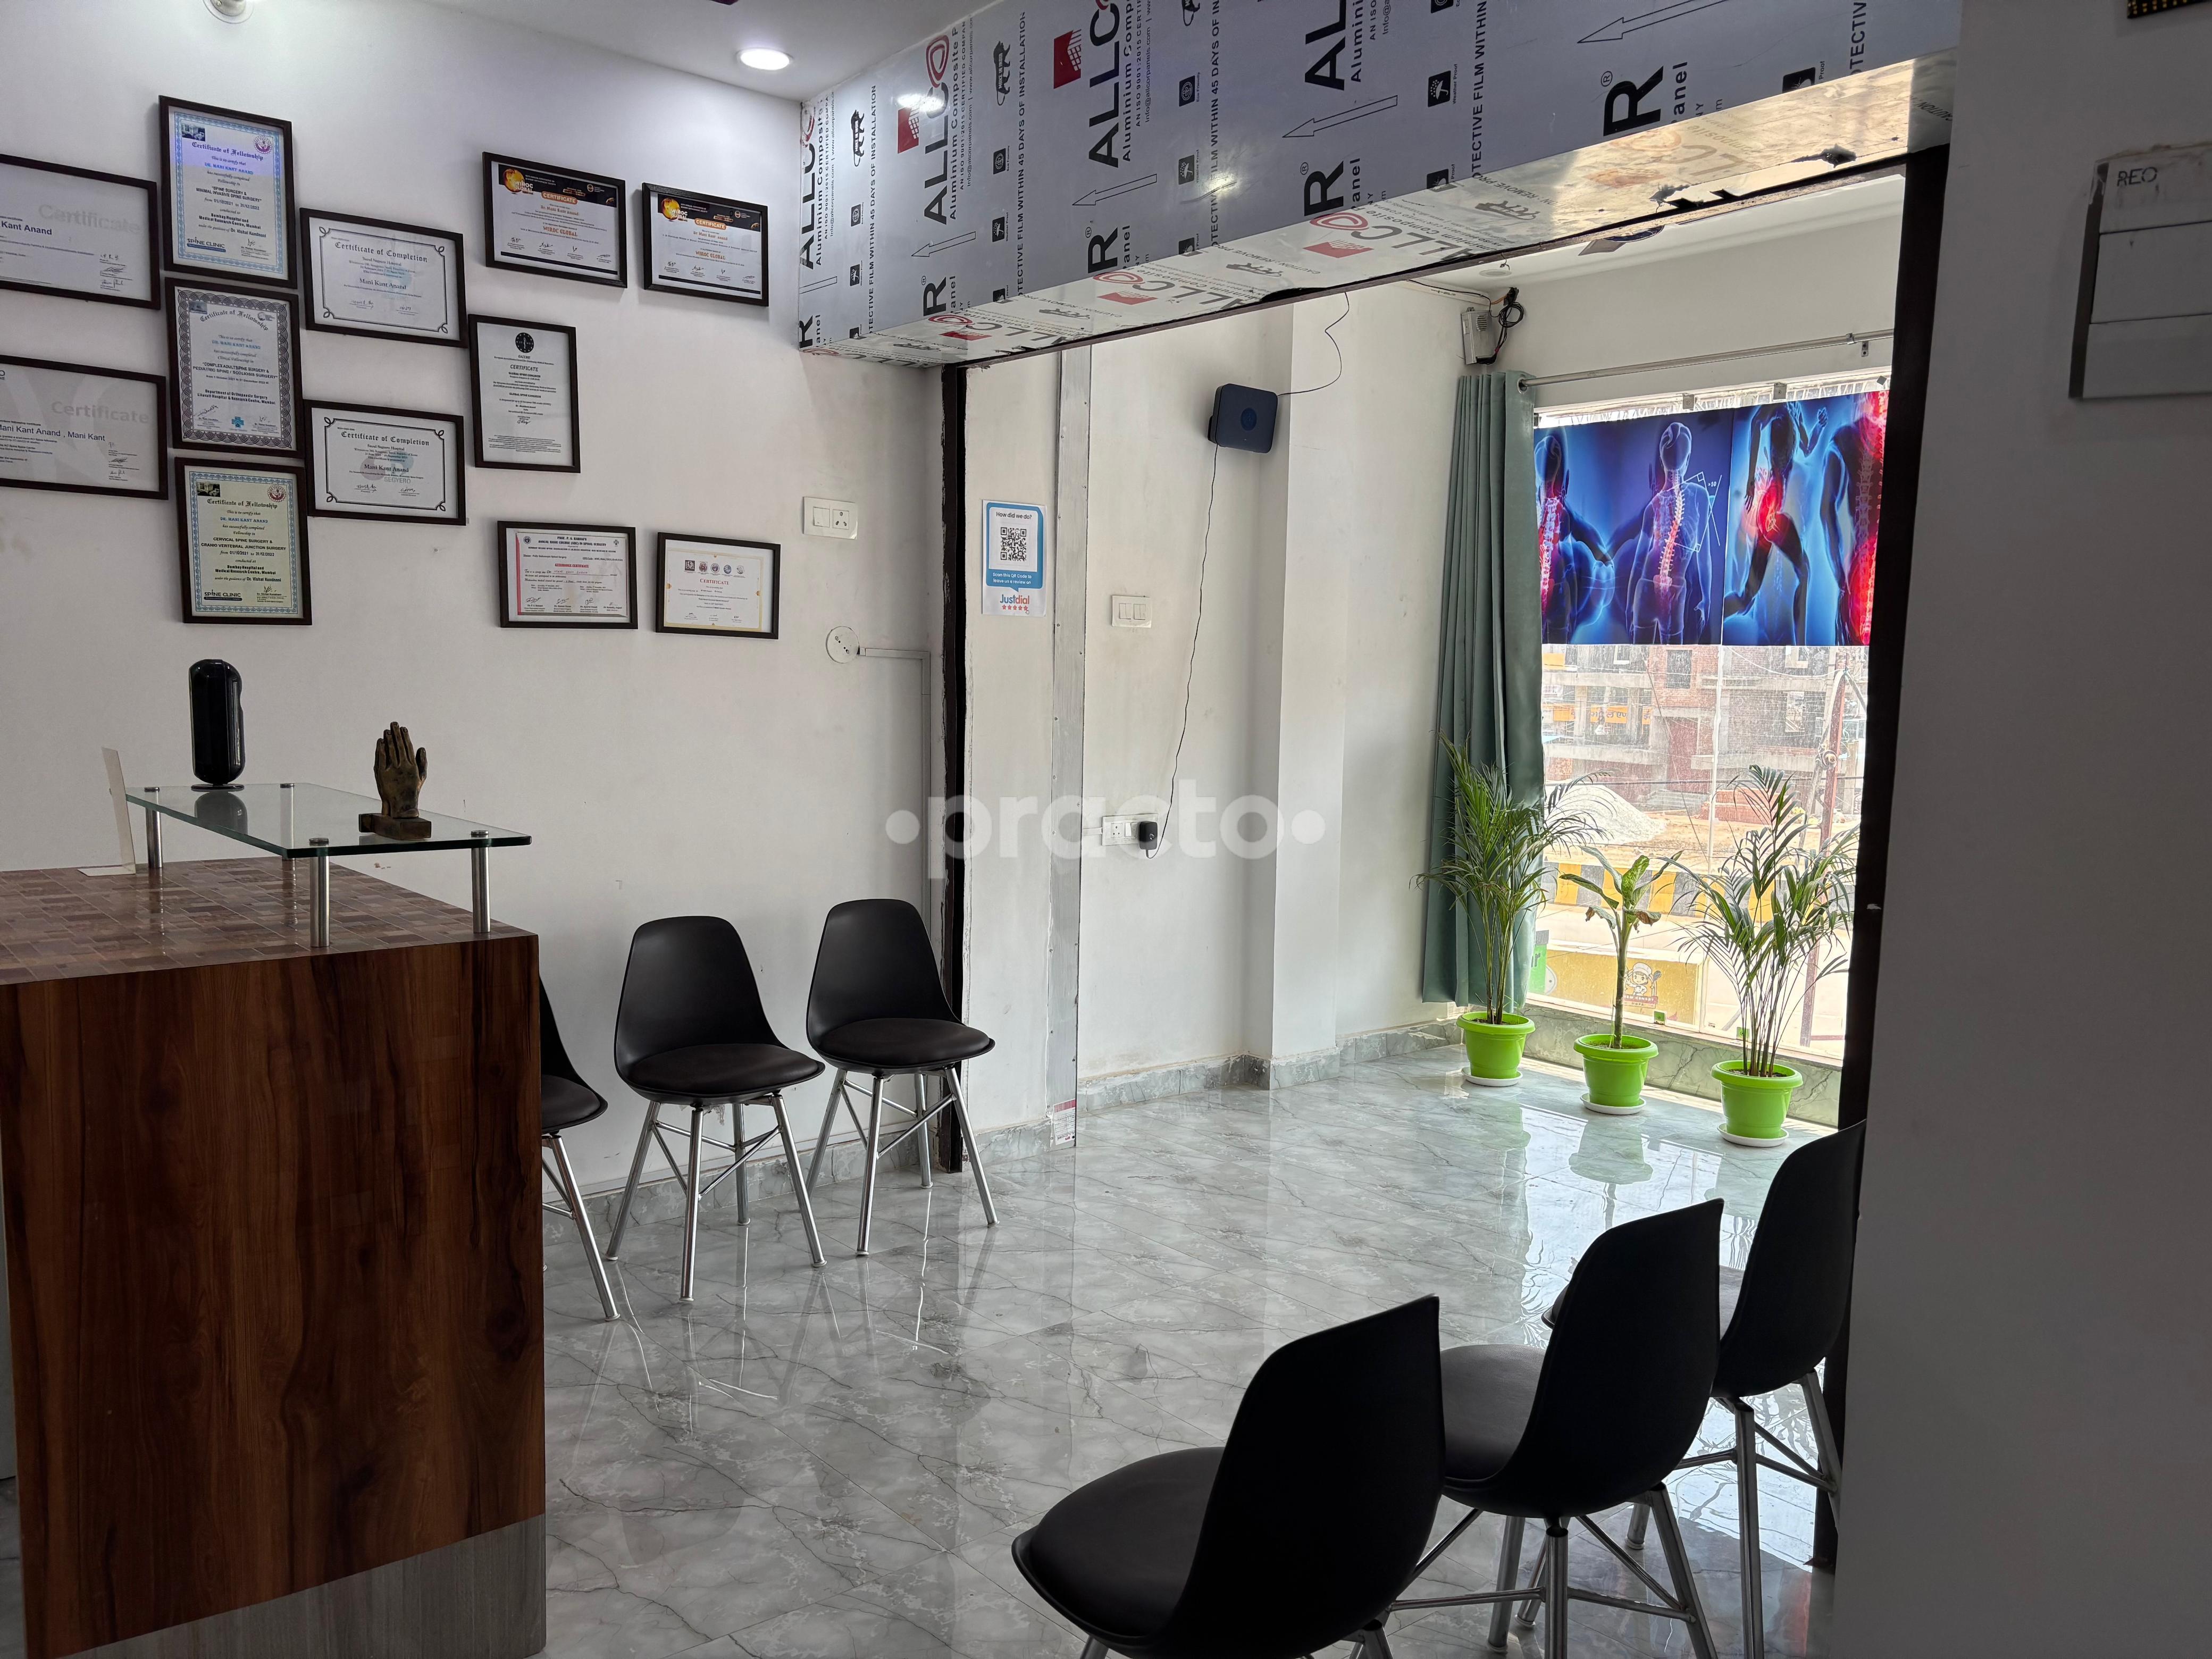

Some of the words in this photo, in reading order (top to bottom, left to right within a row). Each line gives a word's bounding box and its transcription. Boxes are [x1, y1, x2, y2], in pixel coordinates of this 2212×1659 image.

[1212, 19, 1219, 36] OF
[1370, 25, 1376, 40] AN
[1475, 1, 1487, 59] WITHIN
[1212, 80, 1219, 95] 45
[1473, 62, 1485, 100] FILM
[1019, 101, 1025, 116] OF
[1603, 65, 1664, 137] R
[1123, 63, 1132, 162] Aluminium
[1136, 113, 1141, 127] AN
[192, 141, 221, 153] Certificate
[231, 149, 264, 161] Fellowship
[1018, 154, 1024, 165] 45
[870, 162, 876, 177] OF
[514, 180, 534, 189] WIROC
[960, 178, 964, 190] AN
[1304, 161, 1344, 217] R
[542, 192, 576, 204] CERTIFICATE
[38, 204, 141, 234] Certificate
[671, 208, 688, 216] WIROC
[870, 210, 875, 220] 45
[1, 221, 22, 231] Kant
[24, 224, 52, 236] Anand
[696, 219, 726, 230] CERTIFICATE
[559, 229, 578, 237] GLOBAL
[187, 237, 205, 245] SPINE
[335, 241, 374, 254] Certificate
[386, 250, 428, 263] Completion
[1087, 227, 1118, 274] R
[923, 276, 946, 316] R
[200, 310, 228, 322] Certificate
[237, 311, 269, 331] Fellowship
[51, 401, 150, 424] Certificate
[16, 425, 35, 434] Kant
[36, 428, 61, 437] Anand
[68, 431, 86, 440] Mani
[88, 433, 106, 441] Kant
[341, 431, 379, 442] Certificate
[390, 436, 430, 446] Completion
[245, 501, 278, 509] Fellowship
[1000, 593, 1030, 605] Justdial
